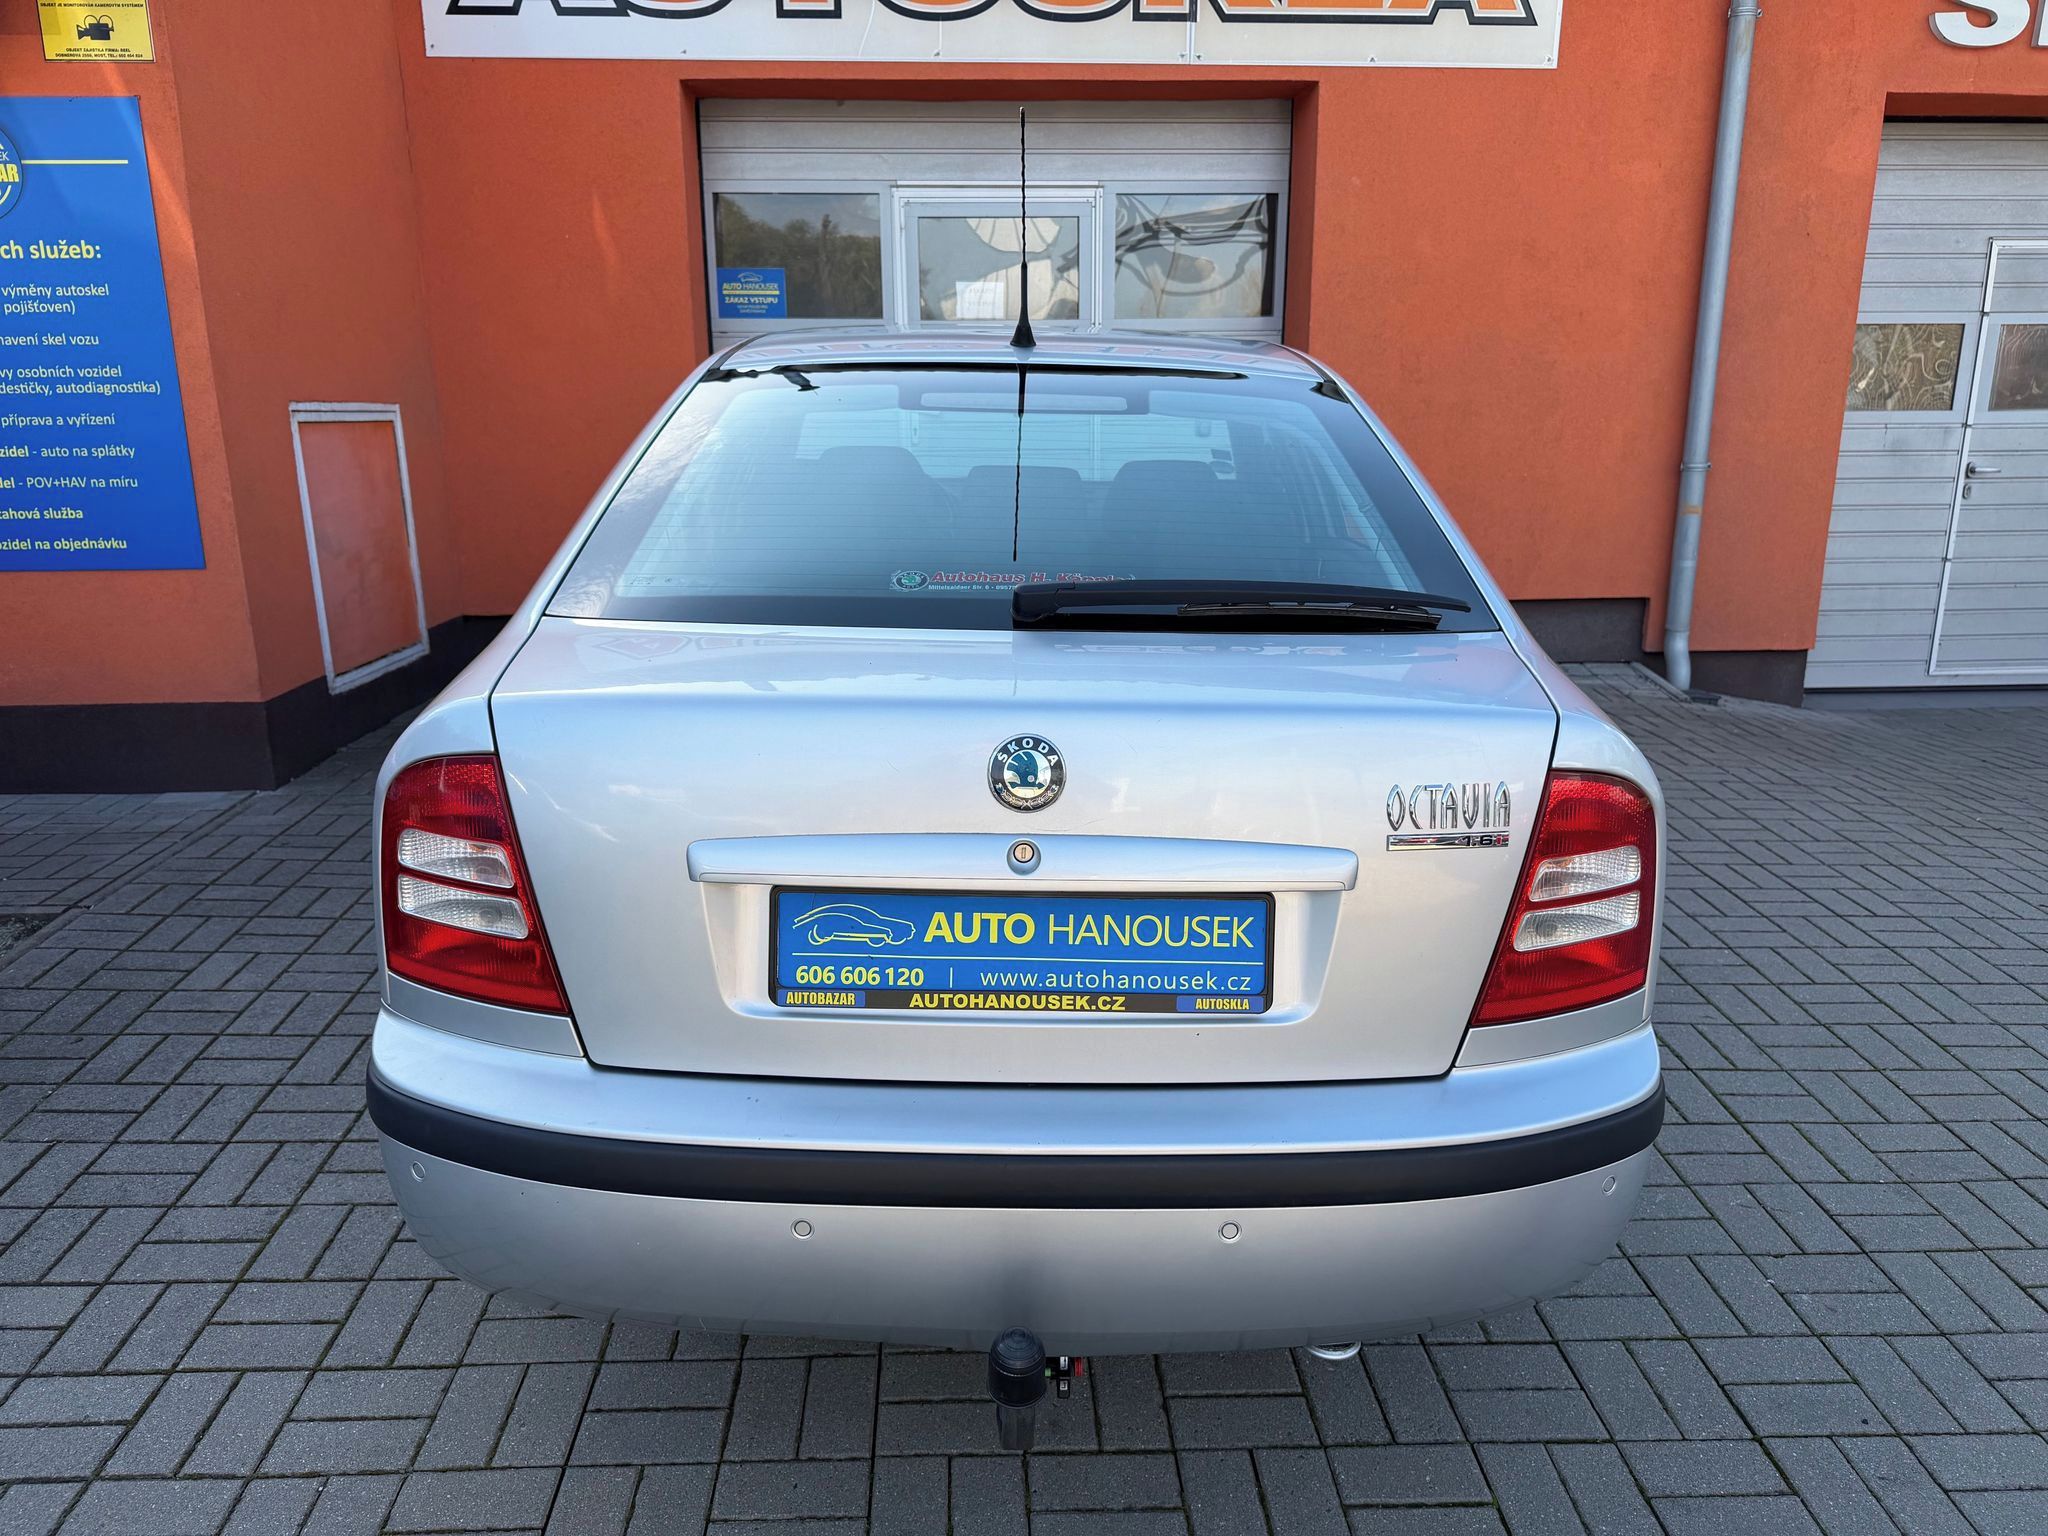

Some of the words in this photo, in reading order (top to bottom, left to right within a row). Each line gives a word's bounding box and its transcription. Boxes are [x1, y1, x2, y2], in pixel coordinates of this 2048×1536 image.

[0, 240, 24, 259] ch
[29, 239, 102, 259] služeb:
[1, 283, 52, 299] výměny
[55, 283, 110, 296] autoskel
[3, 299, 76, 315] pojišťoven)
[42, 333, 66, 346] skel
[69, 335, 99, 346] vozu
[17, 365, 75, 378] osobních
[77, 365, 122, 378] vozidel
[56, 380, 161, 396] autodiagnostika)
[1, 413, 53, 428] příprava
[56, 416, 64, 426] a
[66, 413, 116, 428] vyřízení
[40, 446, 69, 457] auto
[73, 447, 89, 457] na
[91, 444, 136, 459] splátky
[26, 477, 87, 488] POV+HAV
[90, 478, 106, 488] na
[109, 475, 139, 488] míru
[43, 507, 84, 519] služba
[35, 540, 51, 550] na
[53, 537, 127, 552] objednávku
[930, 571, 1026, 583] Autohaus
[1386, 781, 1511, 831] OCTAVIA
[924, 911, 1035, 944] AUTO
[1049, 913, 1254, 948] HANOUSEK
[795, 966, 836, 985] 606
[840, 966, 881, 986] 606
[884, 967, 925, 987] 120
[980, 969, 1251, 991] www.autohanousek.cz
[786, 991, 855, 1005] AUTOBAZAR
[909, 993, 1126, 1011] AUTOHANOUSEK.CZ
[1195, 998, 1250, 1010] AUTOSKLA
